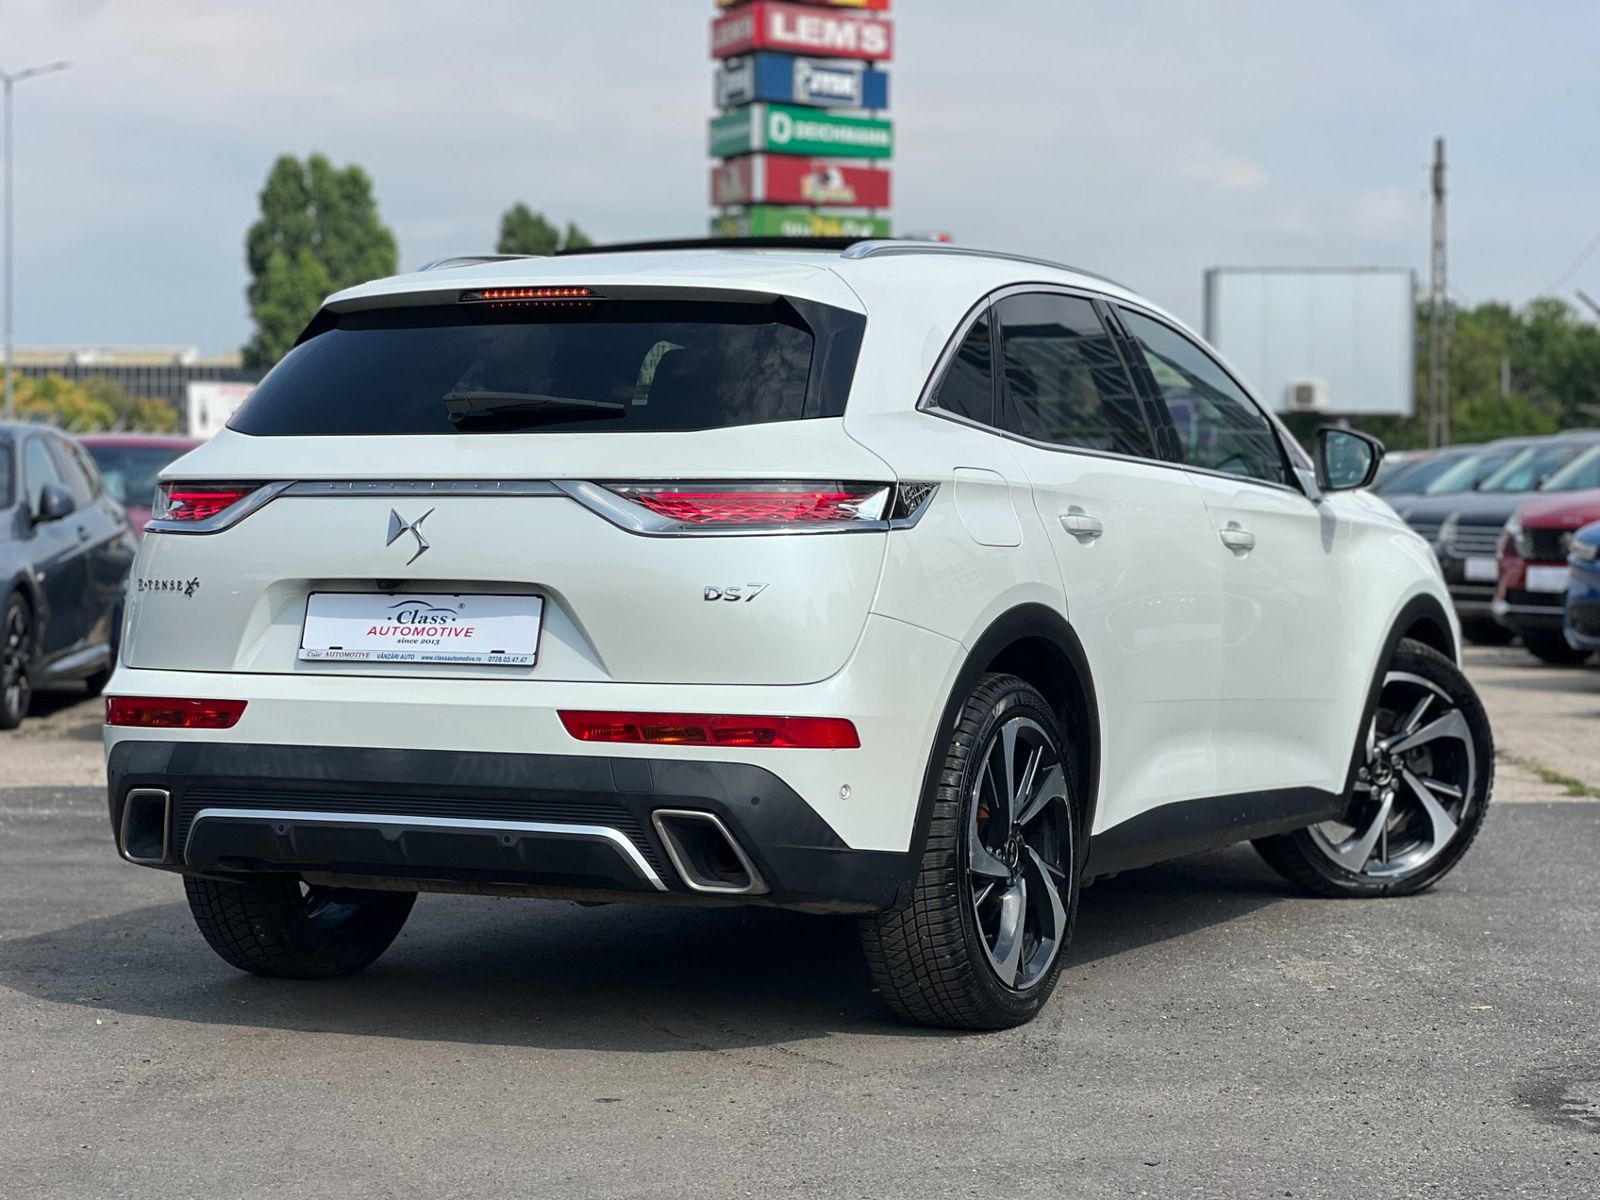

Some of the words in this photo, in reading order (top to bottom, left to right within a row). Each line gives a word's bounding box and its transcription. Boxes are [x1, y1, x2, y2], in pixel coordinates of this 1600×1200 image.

[396, 609, 448, 625] Class
[367, 626, 475, 638] AUTOMOTIVE
[419, 638, 441, 646] 2013
[324, 651, 370, 659] AUTOMOTIVE
[400, 653, 416, 661] AUTO
[421, 654, 482, 663] www.classautomotive.ro
